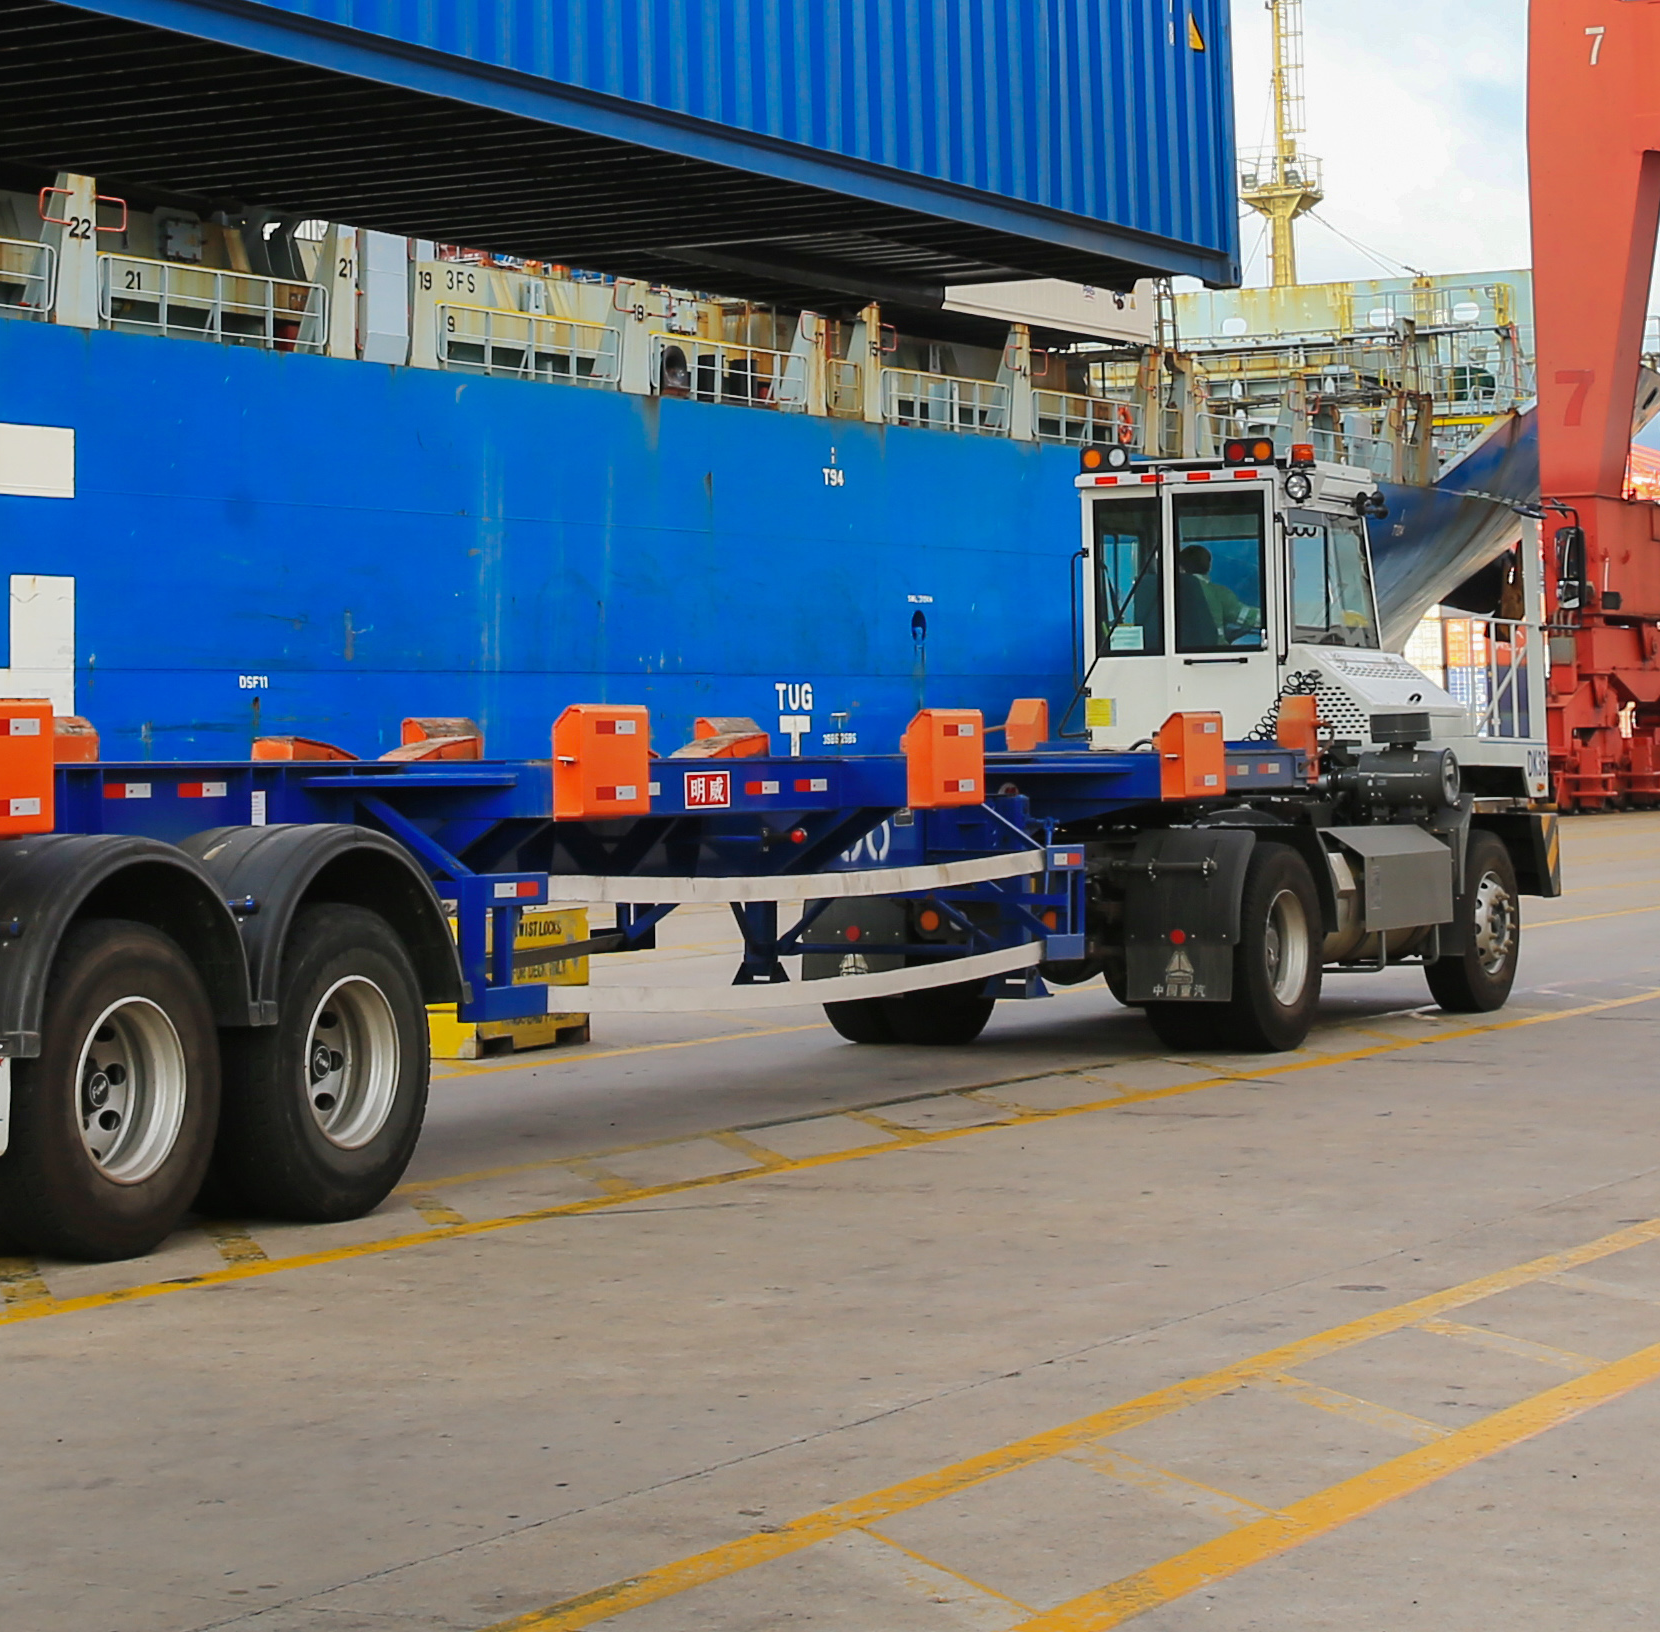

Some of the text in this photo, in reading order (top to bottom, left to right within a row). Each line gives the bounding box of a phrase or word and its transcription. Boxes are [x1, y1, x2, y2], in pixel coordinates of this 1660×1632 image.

[1584, 25, 1606, 67] 7
[69, 216, 91, 241] 22
[125, 270, 142, 291] 21
[338, 258, 353, 279] 21
[418, 269, 476, 294] 19 3FS
[822, 468, 845, 487] T94
[774, 682, 813, 711] TUG
[690, 776, 725, 803] 明威
[515, 920, 539, 938] WIST
